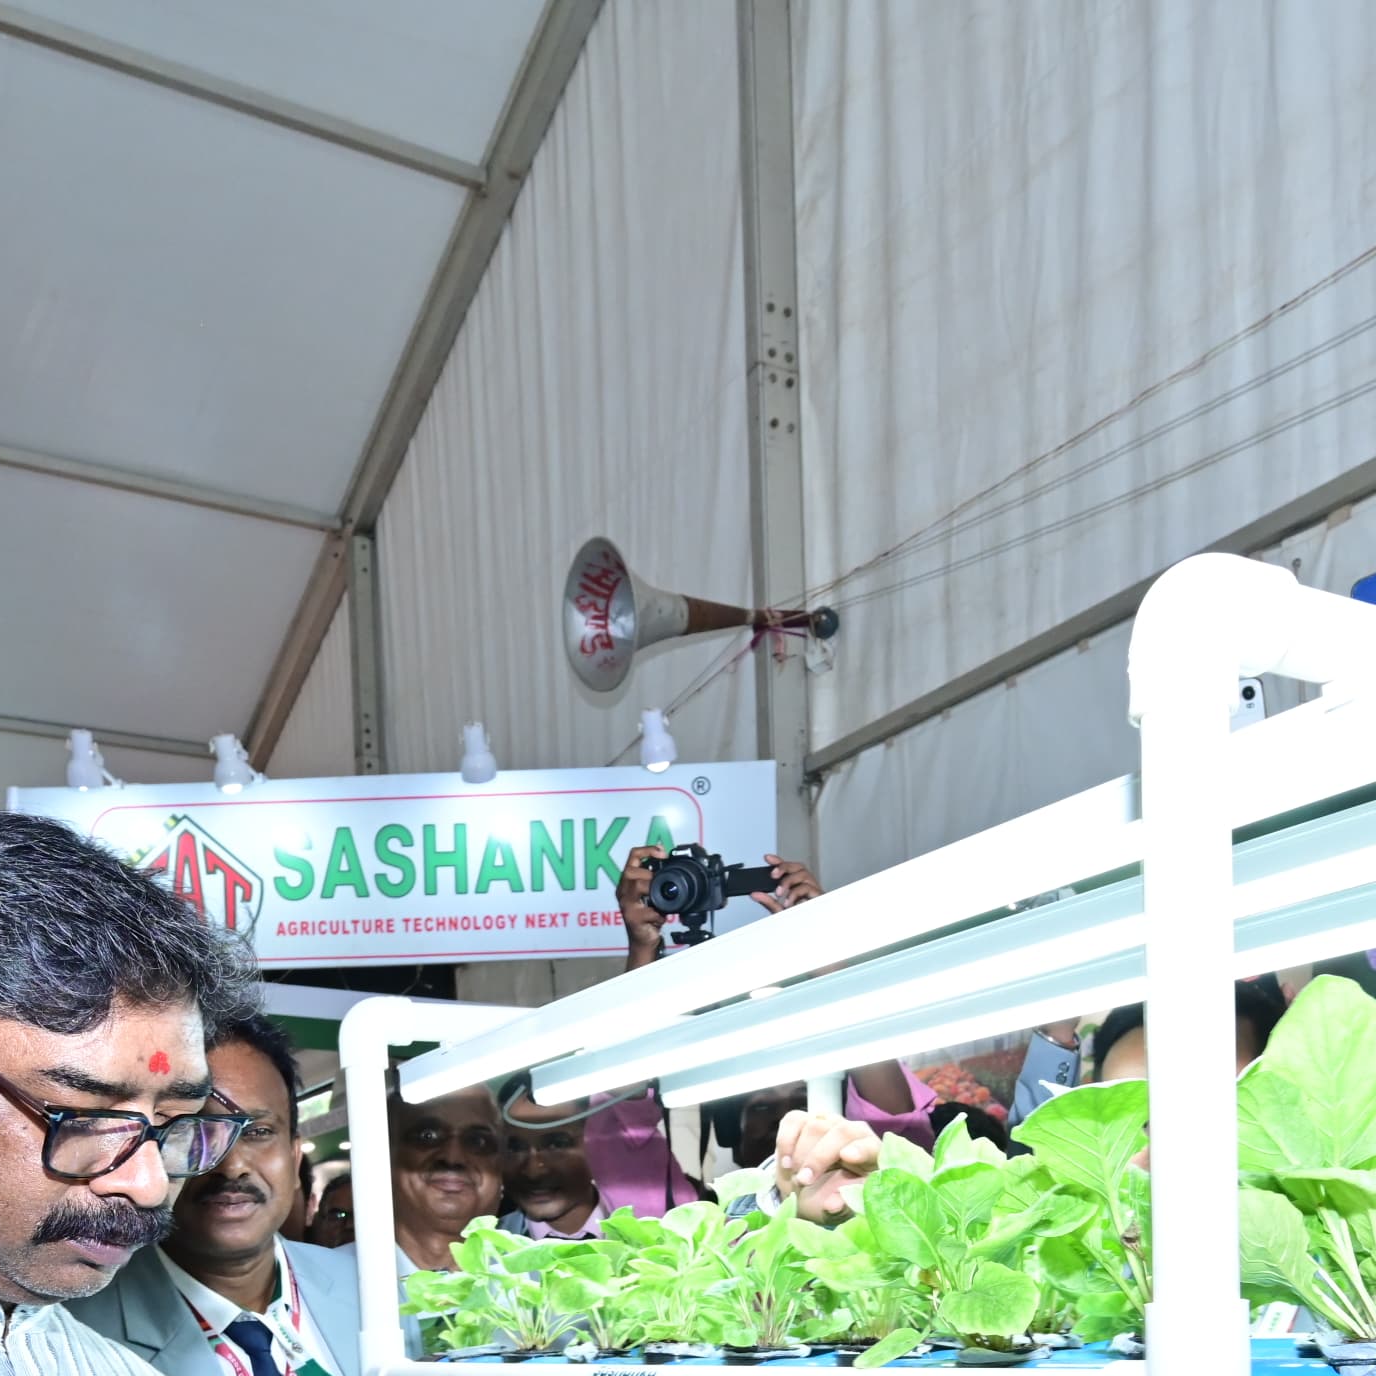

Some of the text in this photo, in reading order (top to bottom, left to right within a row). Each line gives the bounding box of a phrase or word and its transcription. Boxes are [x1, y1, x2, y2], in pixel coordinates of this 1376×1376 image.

[276, 917, 396, 936] AGRICULTURE
[403, 914, 518, 933] TECHNOLOGY
[525, 912, 570, 929] NEXT
